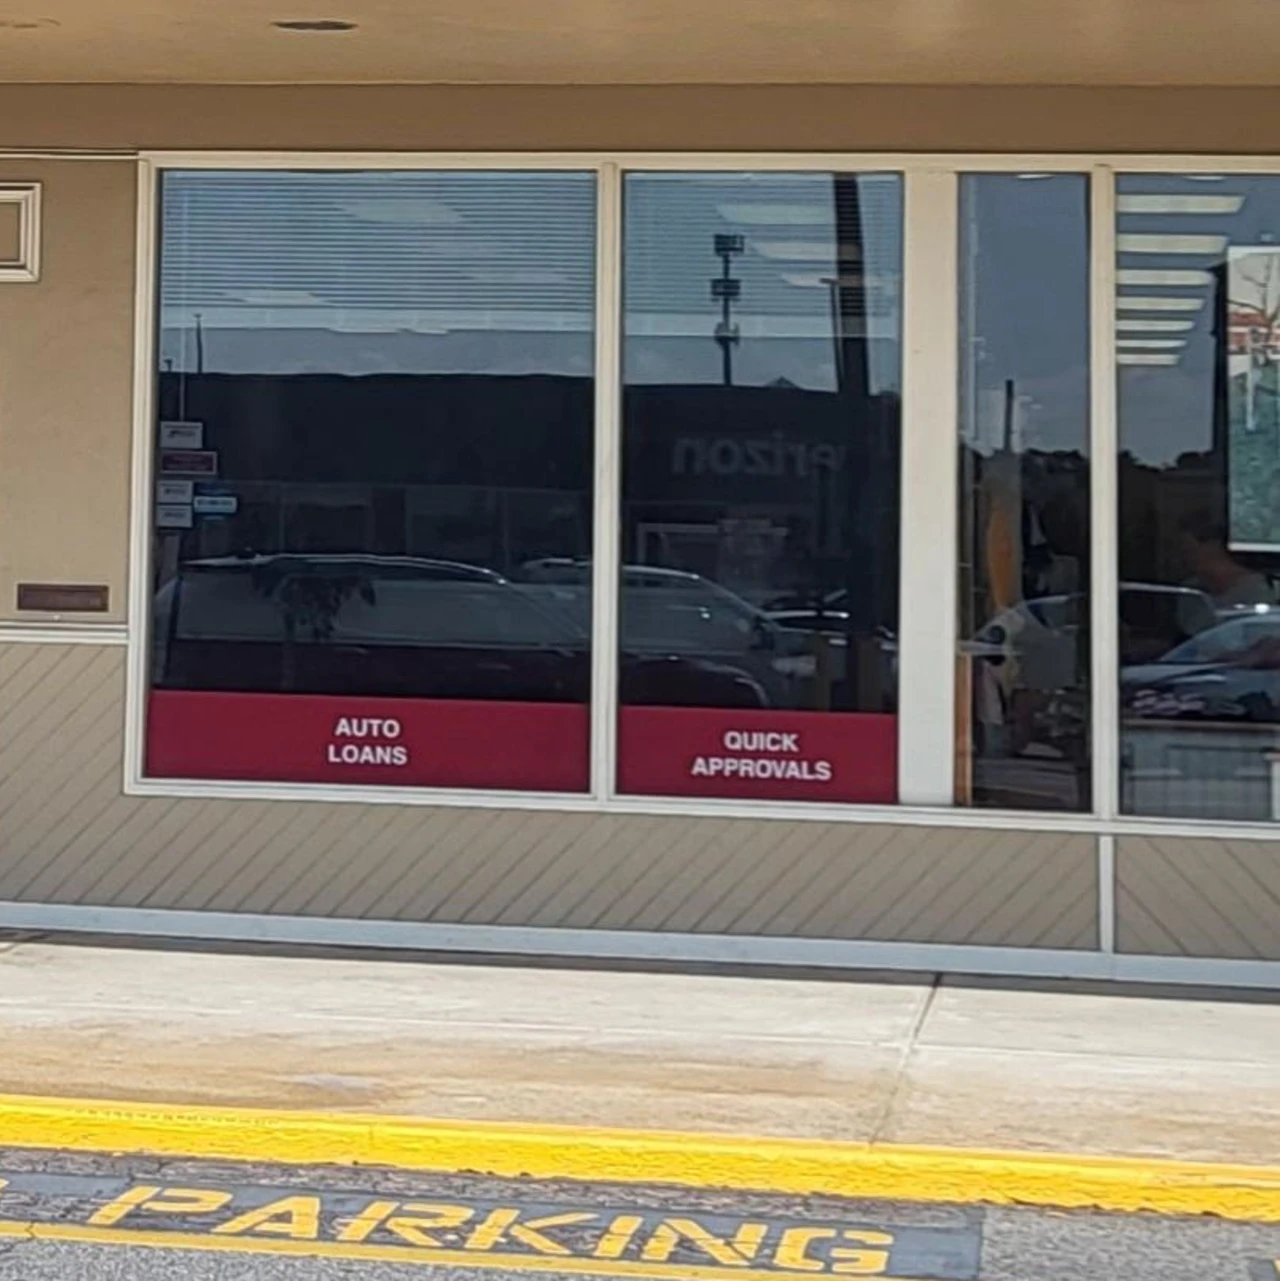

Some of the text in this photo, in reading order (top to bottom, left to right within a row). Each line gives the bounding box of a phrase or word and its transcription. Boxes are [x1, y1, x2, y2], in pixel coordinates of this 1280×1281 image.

[334, 717, 401, 738] AUTO
[724, 730, 800, 753] QUICK
[328, 744, 408, 766] LOANS
[691, 756, 833, 781] APPROVALS
[87, 1184, 895, 1274] PARKING
